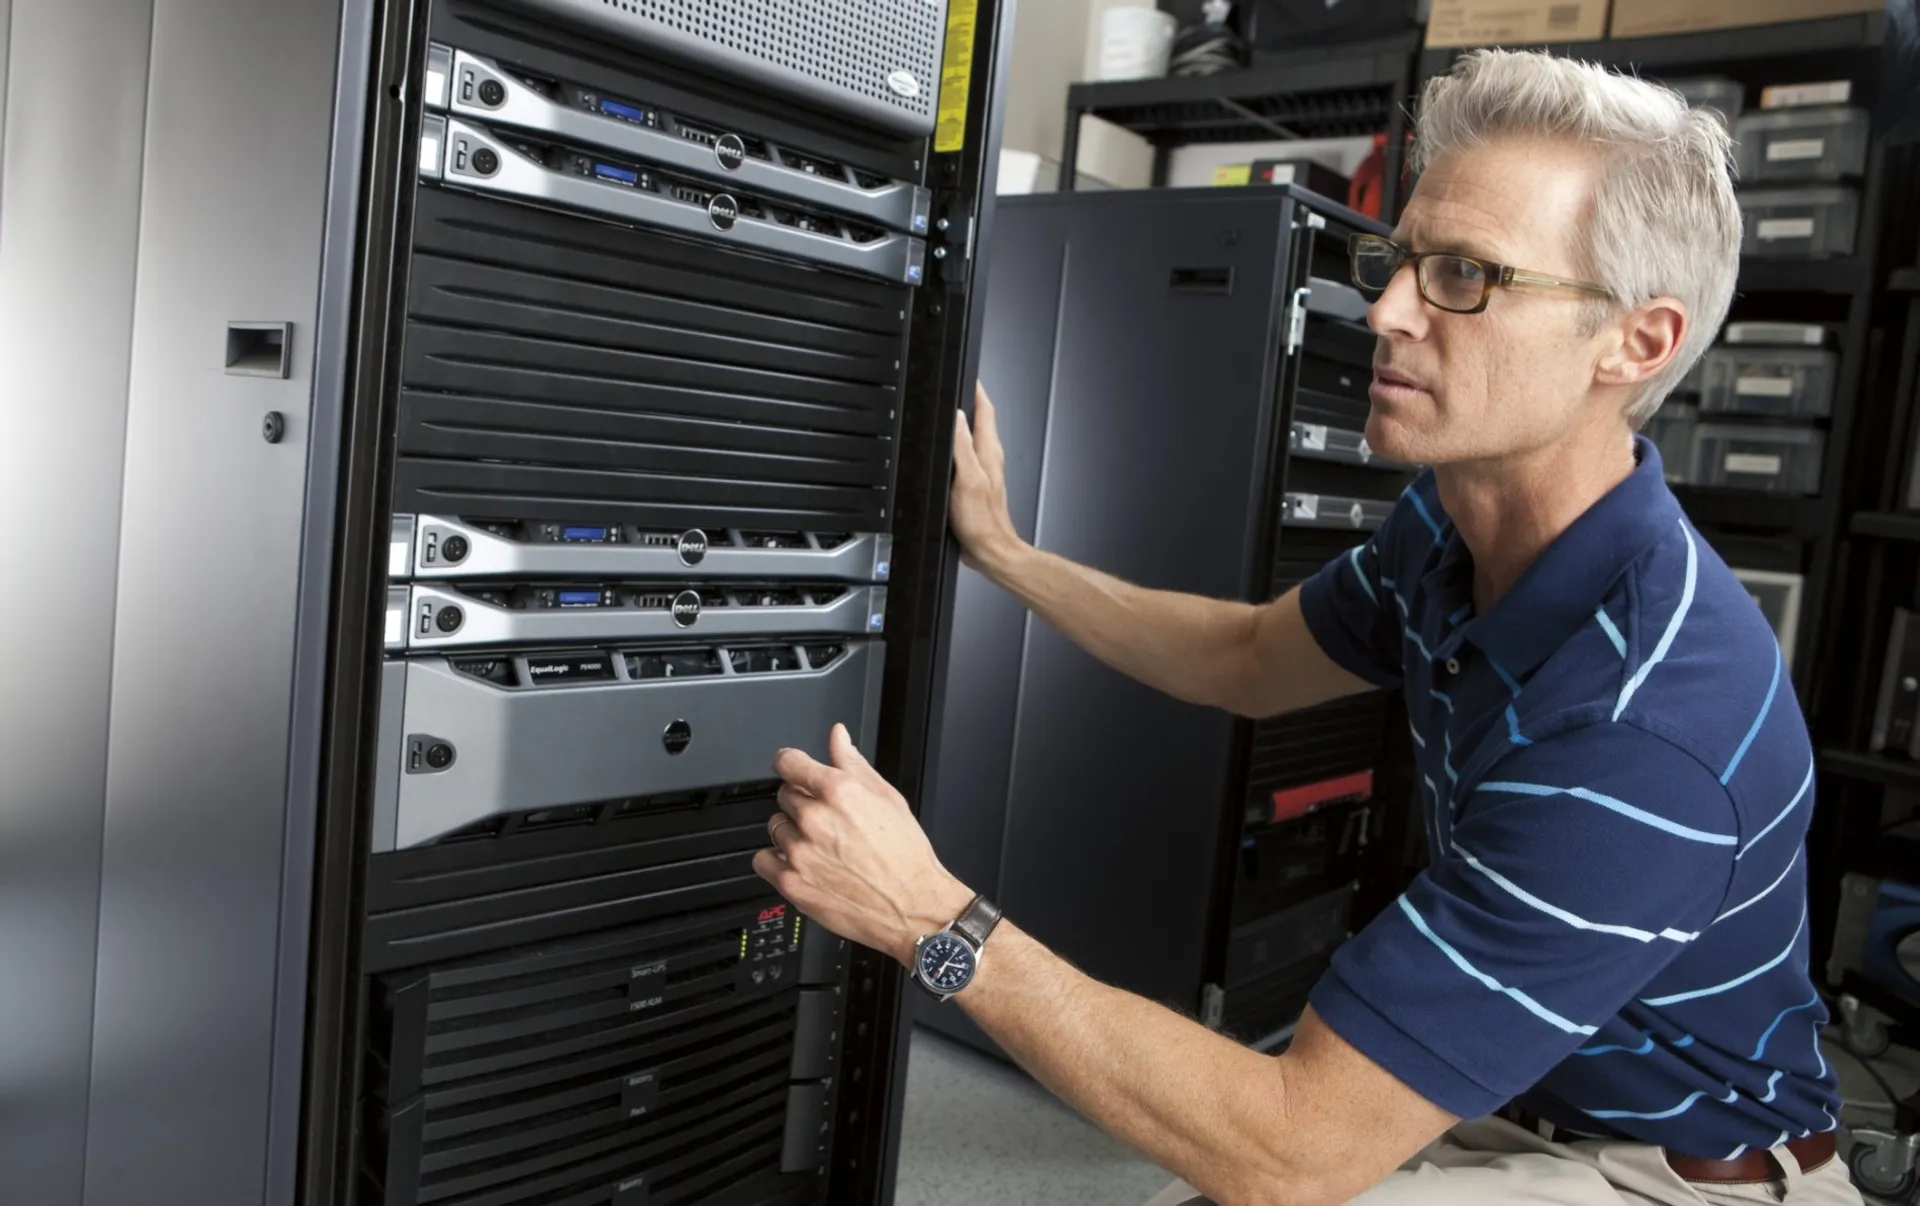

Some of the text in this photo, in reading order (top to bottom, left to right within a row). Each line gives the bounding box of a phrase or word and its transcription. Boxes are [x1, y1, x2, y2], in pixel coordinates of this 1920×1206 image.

[719, 145, 742, 160] DELL
[712, 205, 736, 220] DELL
[681, 543, 705, 553] DELL
[675, 604, 699, 614] DELL
[531, 664, 569, 675] EqualLogic
[758, 904, 786, 921] APC
